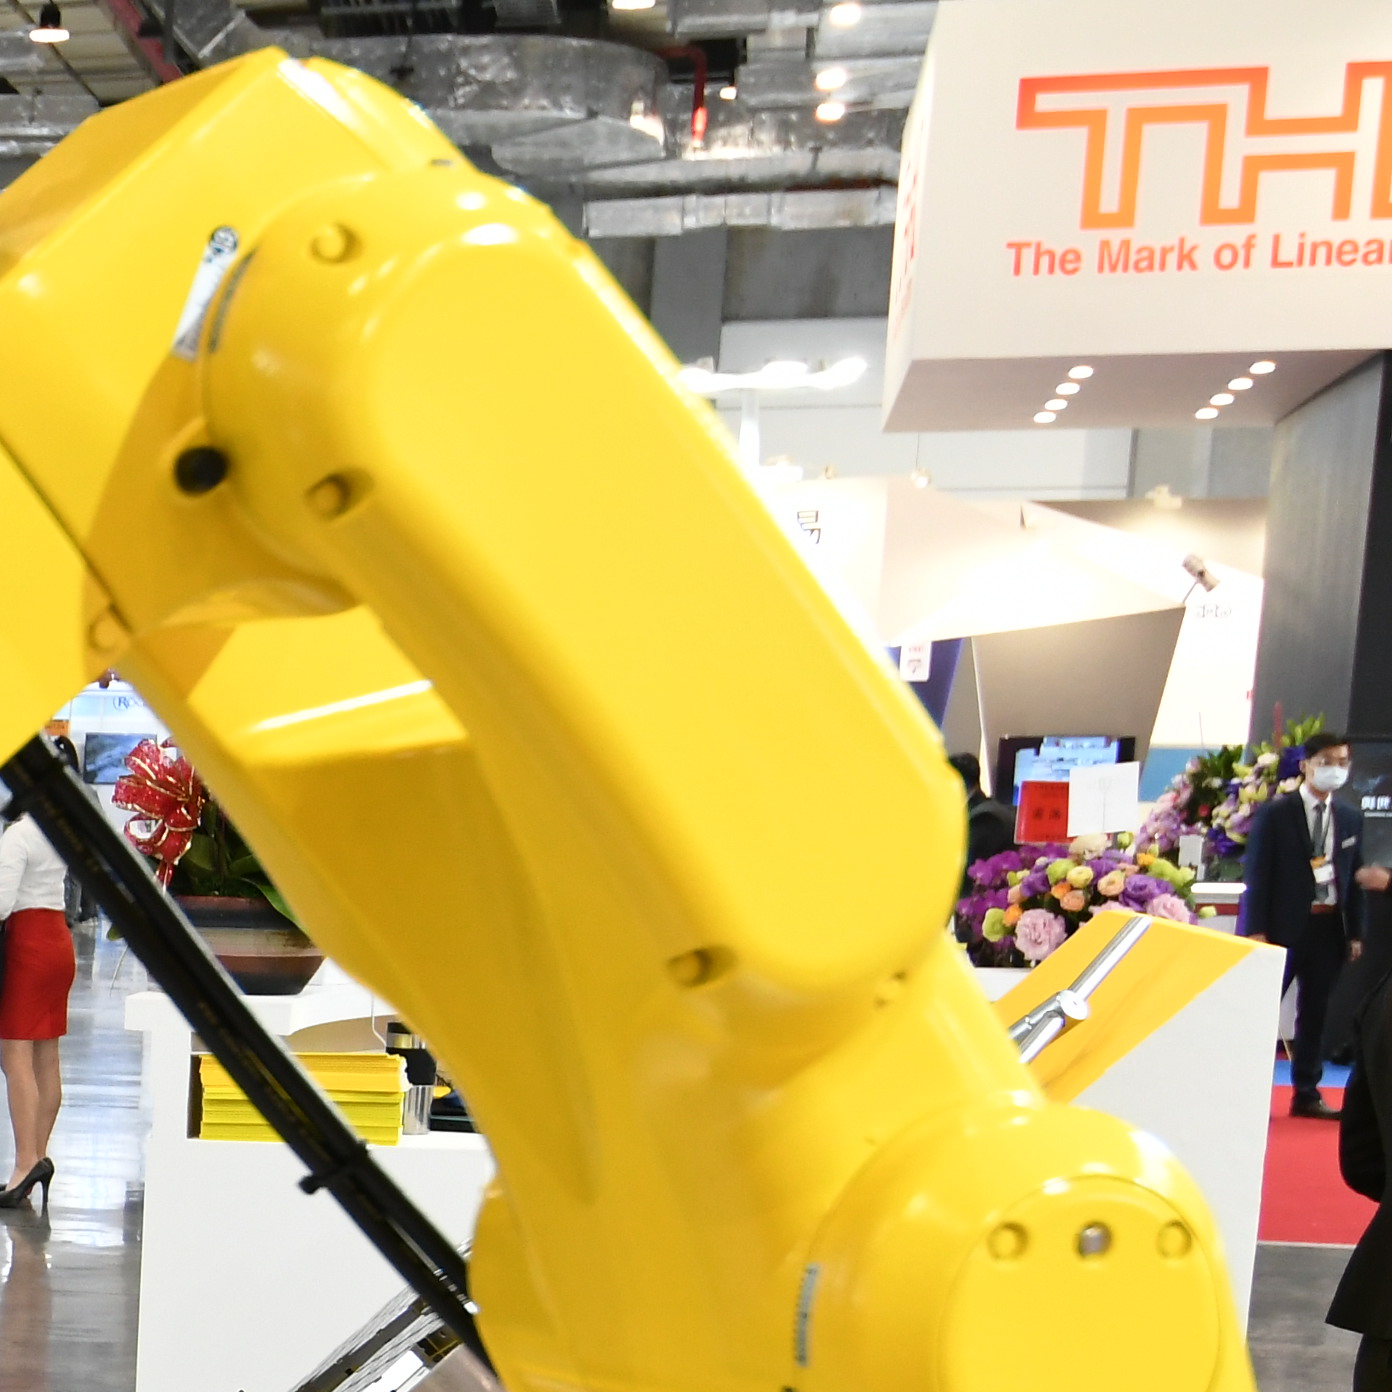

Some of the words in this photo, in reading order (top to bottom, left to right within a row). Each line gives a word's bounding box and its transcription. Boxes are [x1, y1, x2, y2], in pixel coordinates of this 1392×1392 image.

[1016, 61, 1392, 230] TH
[1006, 241, 1082, 276] The
[1097, 237, 1199, 274] Mark
[1214, 233, 1257, 271] of
